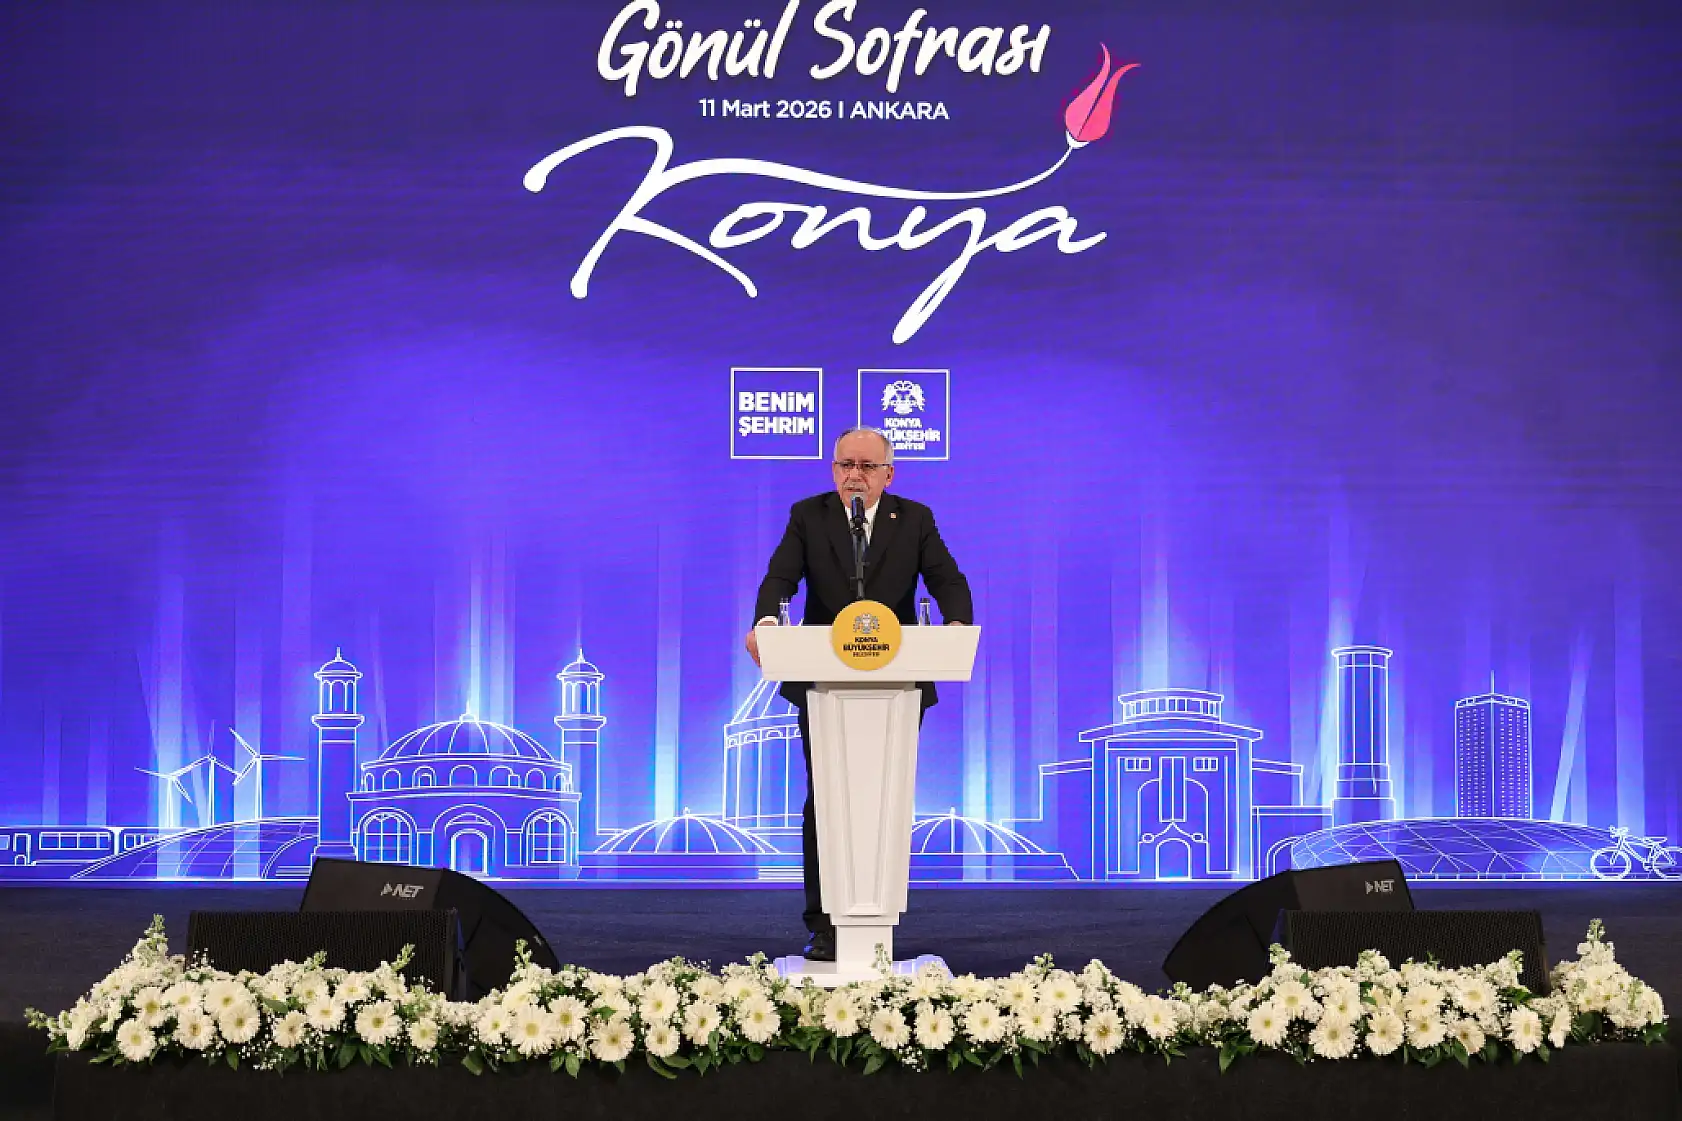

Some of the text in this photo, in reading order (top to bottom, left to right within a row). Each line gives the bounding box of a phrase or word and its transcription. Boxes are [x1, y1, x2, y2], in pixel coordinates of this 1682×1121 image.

[597, 0, 1051, 97] Gönül Sofrası
[699, 98, 715, 117] 11
[722, 99, 771, 119] Mart
[775, 100, 833, 119] 2026
[849, 101, 950, 120] ANKARA
[523, 126, 1107, 344] Konya
[884, 417, 923, 429] KONYA
